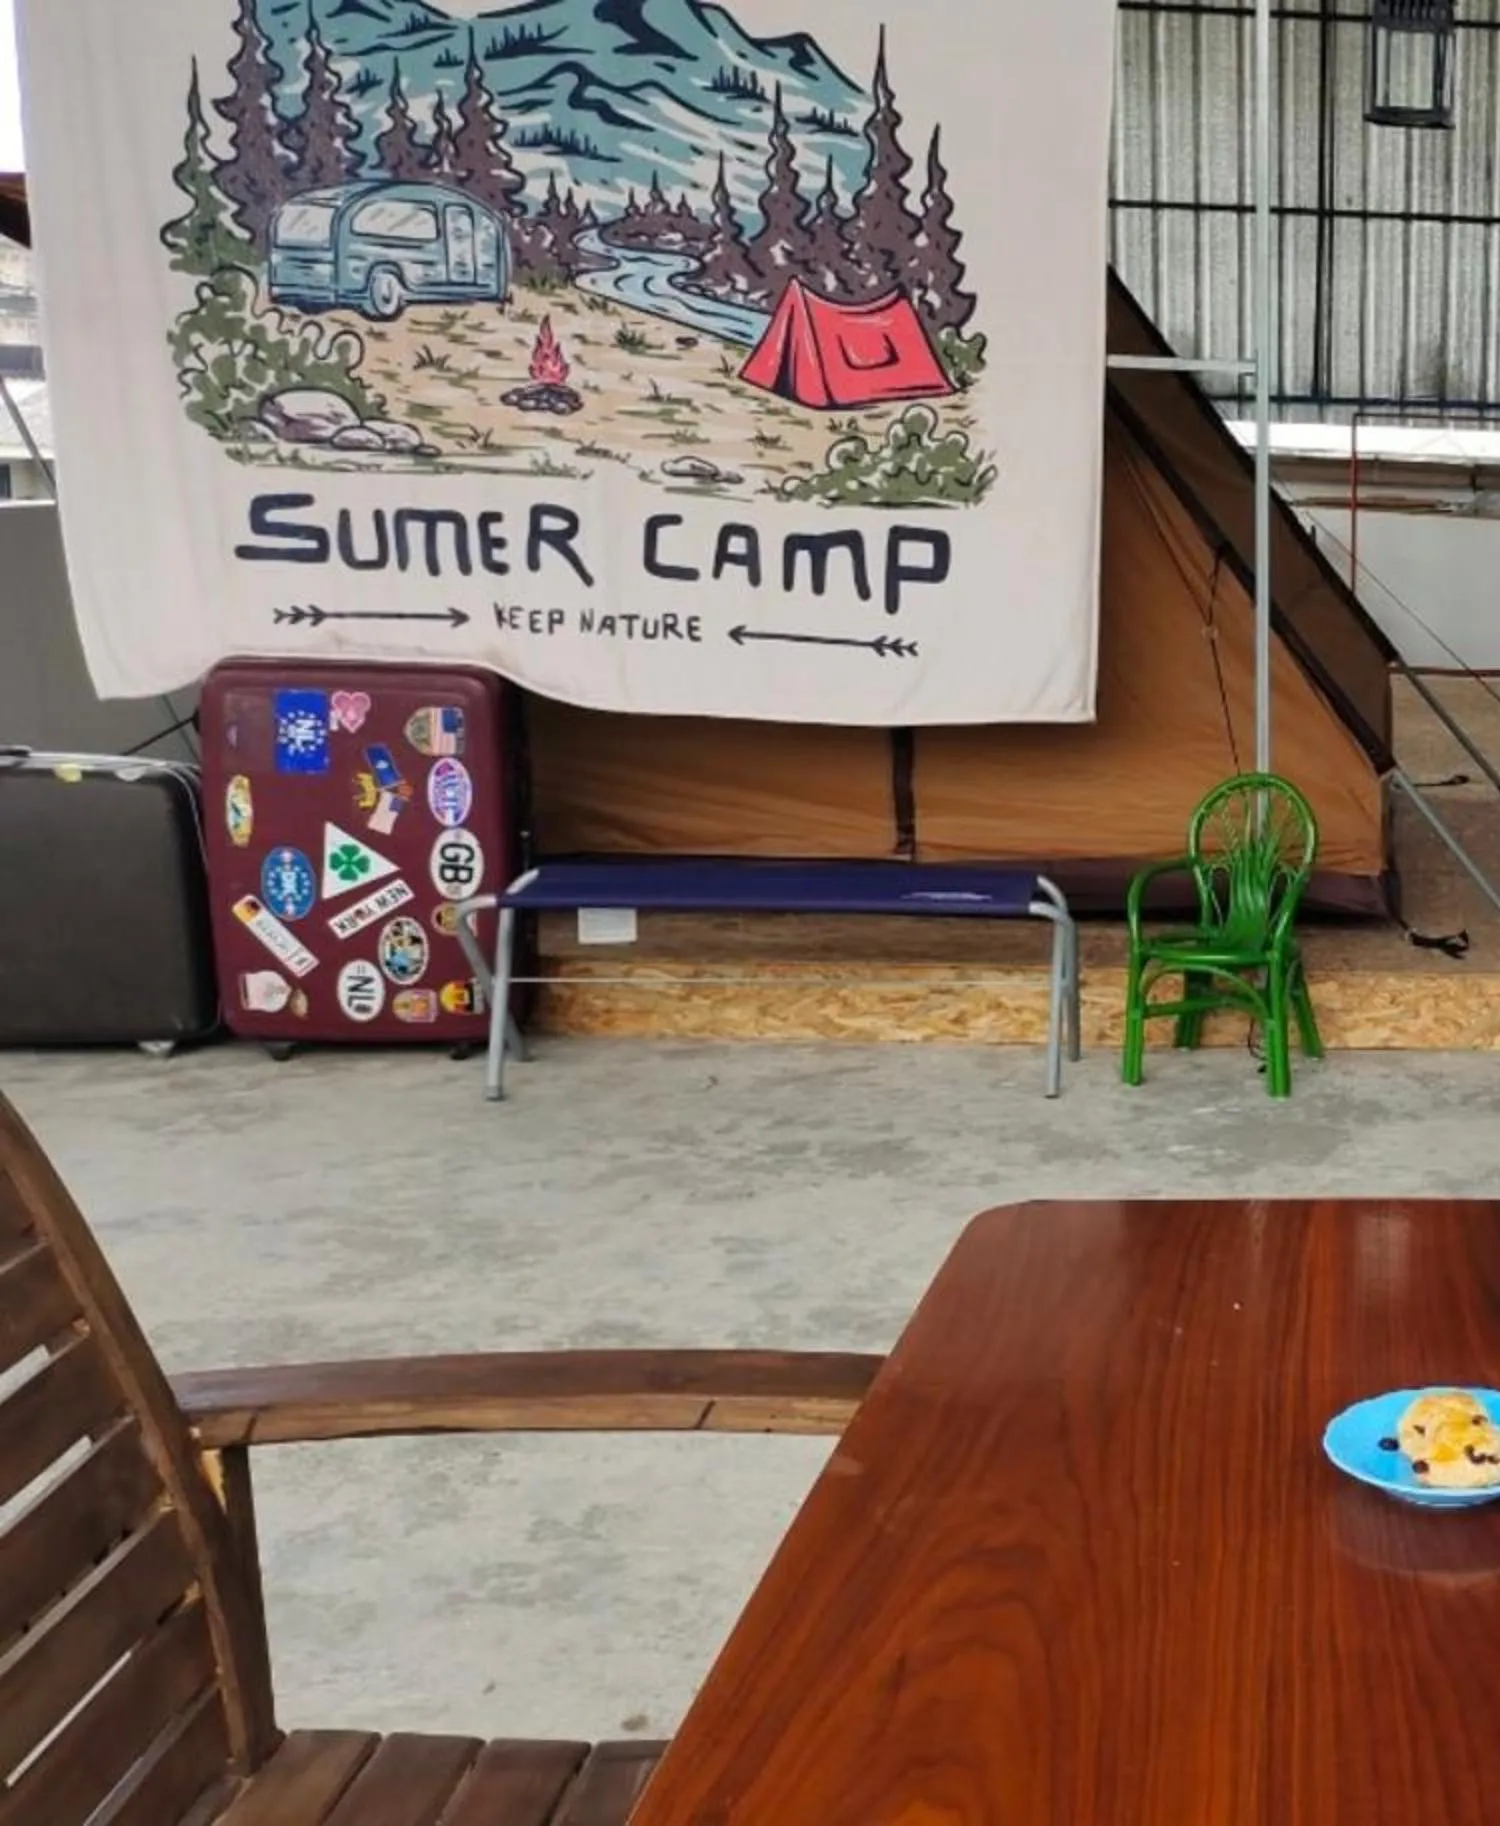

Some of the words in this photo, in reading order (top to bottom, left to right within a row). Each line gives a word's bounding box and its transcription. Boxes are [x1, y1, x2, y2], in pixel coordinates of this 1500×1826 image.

[235, 493, 595, 587] SUMER
[641, 513, 951, 615] CAMP
[493, 602, 565, 635] KEEP
[578, 608, 703, 642] NATURE
[440, 842, 473, 885] GB
[375, 886, 409, 909] NEW
